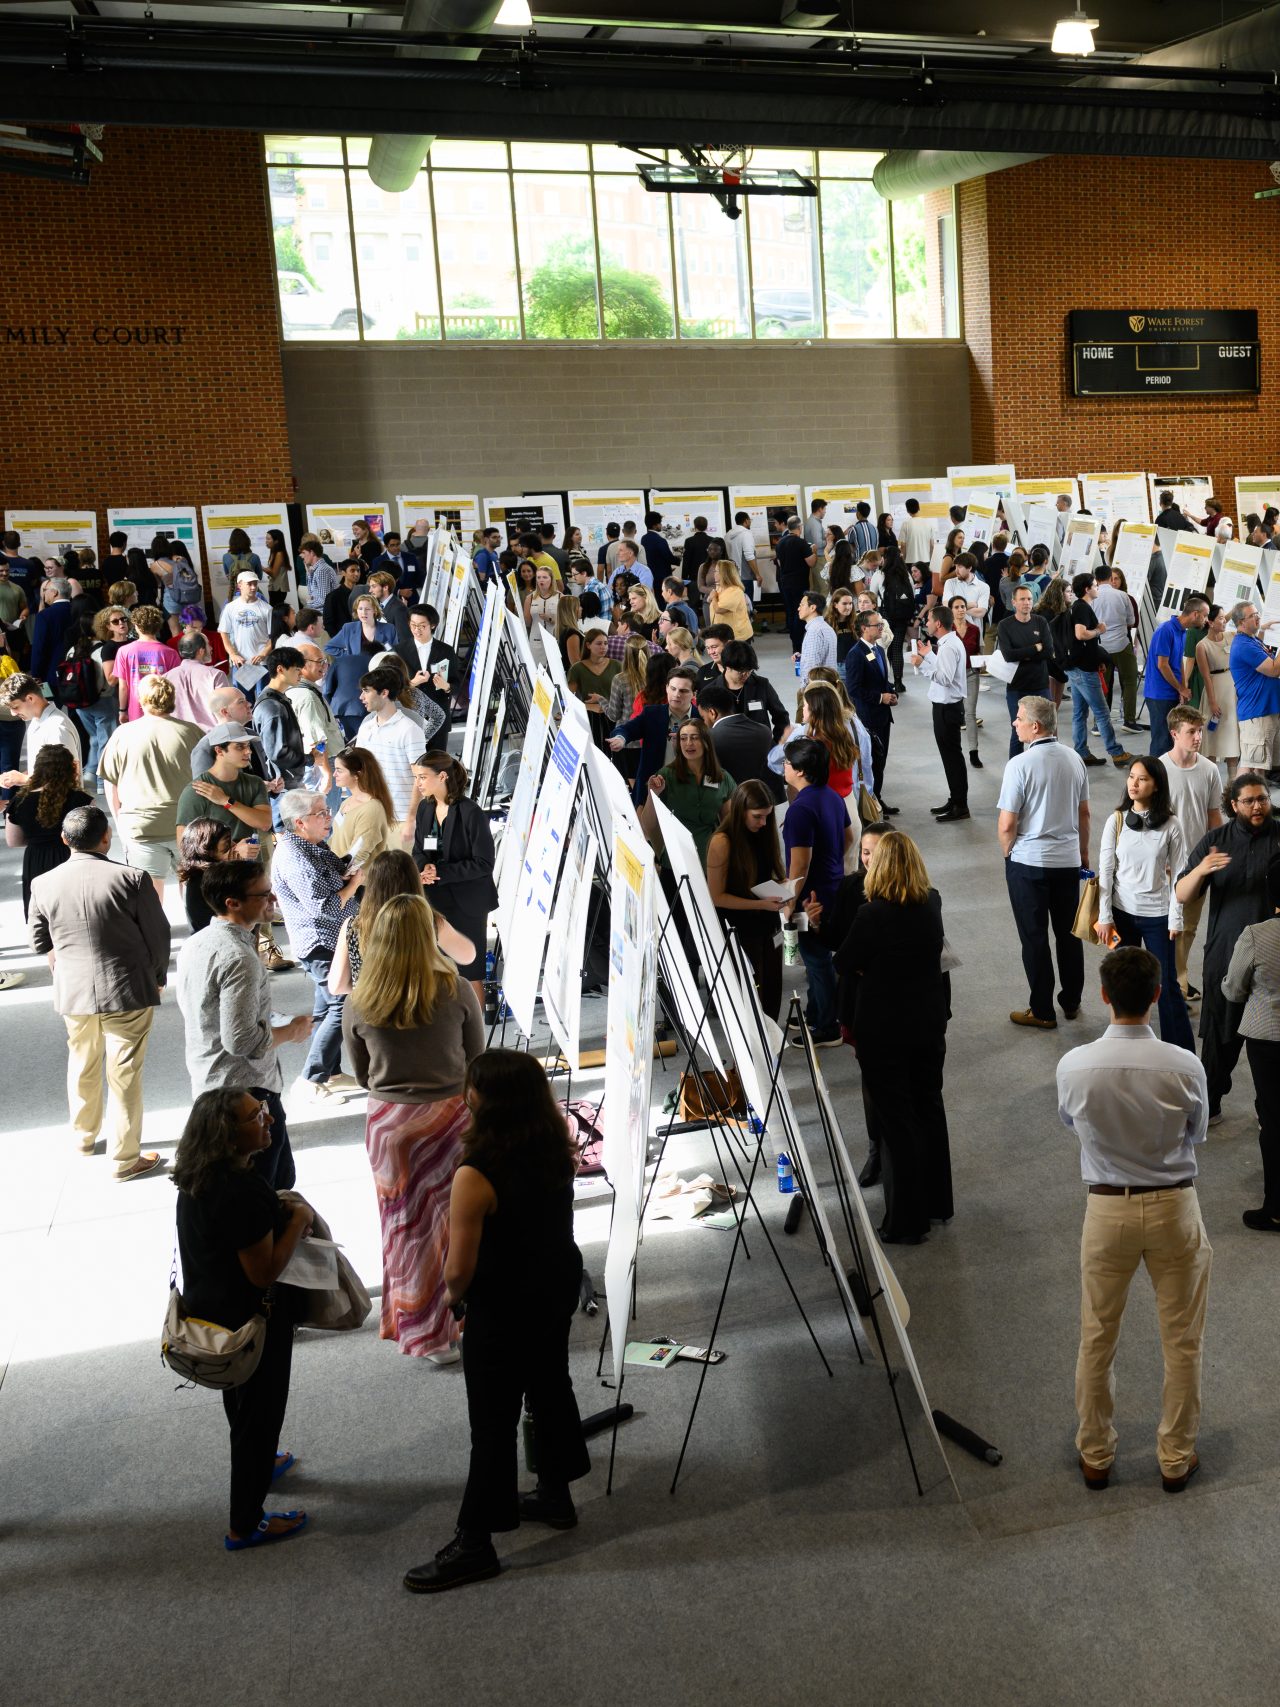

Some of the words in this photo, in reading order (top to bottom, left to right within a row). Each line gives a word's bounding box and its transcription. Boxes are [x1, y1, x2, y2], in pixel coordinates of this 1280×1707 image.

[1147, 316, 1173, 326] WAKE
[1174, 316, 1205, 326] FOREST
[0, 327, 71, 345] MILY
[93, 326, 187, 346] COURT
[1082, 347, 1115, 359] HOME
[1218, 345, 1252, 359] GUEST
[1145, 376, 1172, 385] PERIOD
